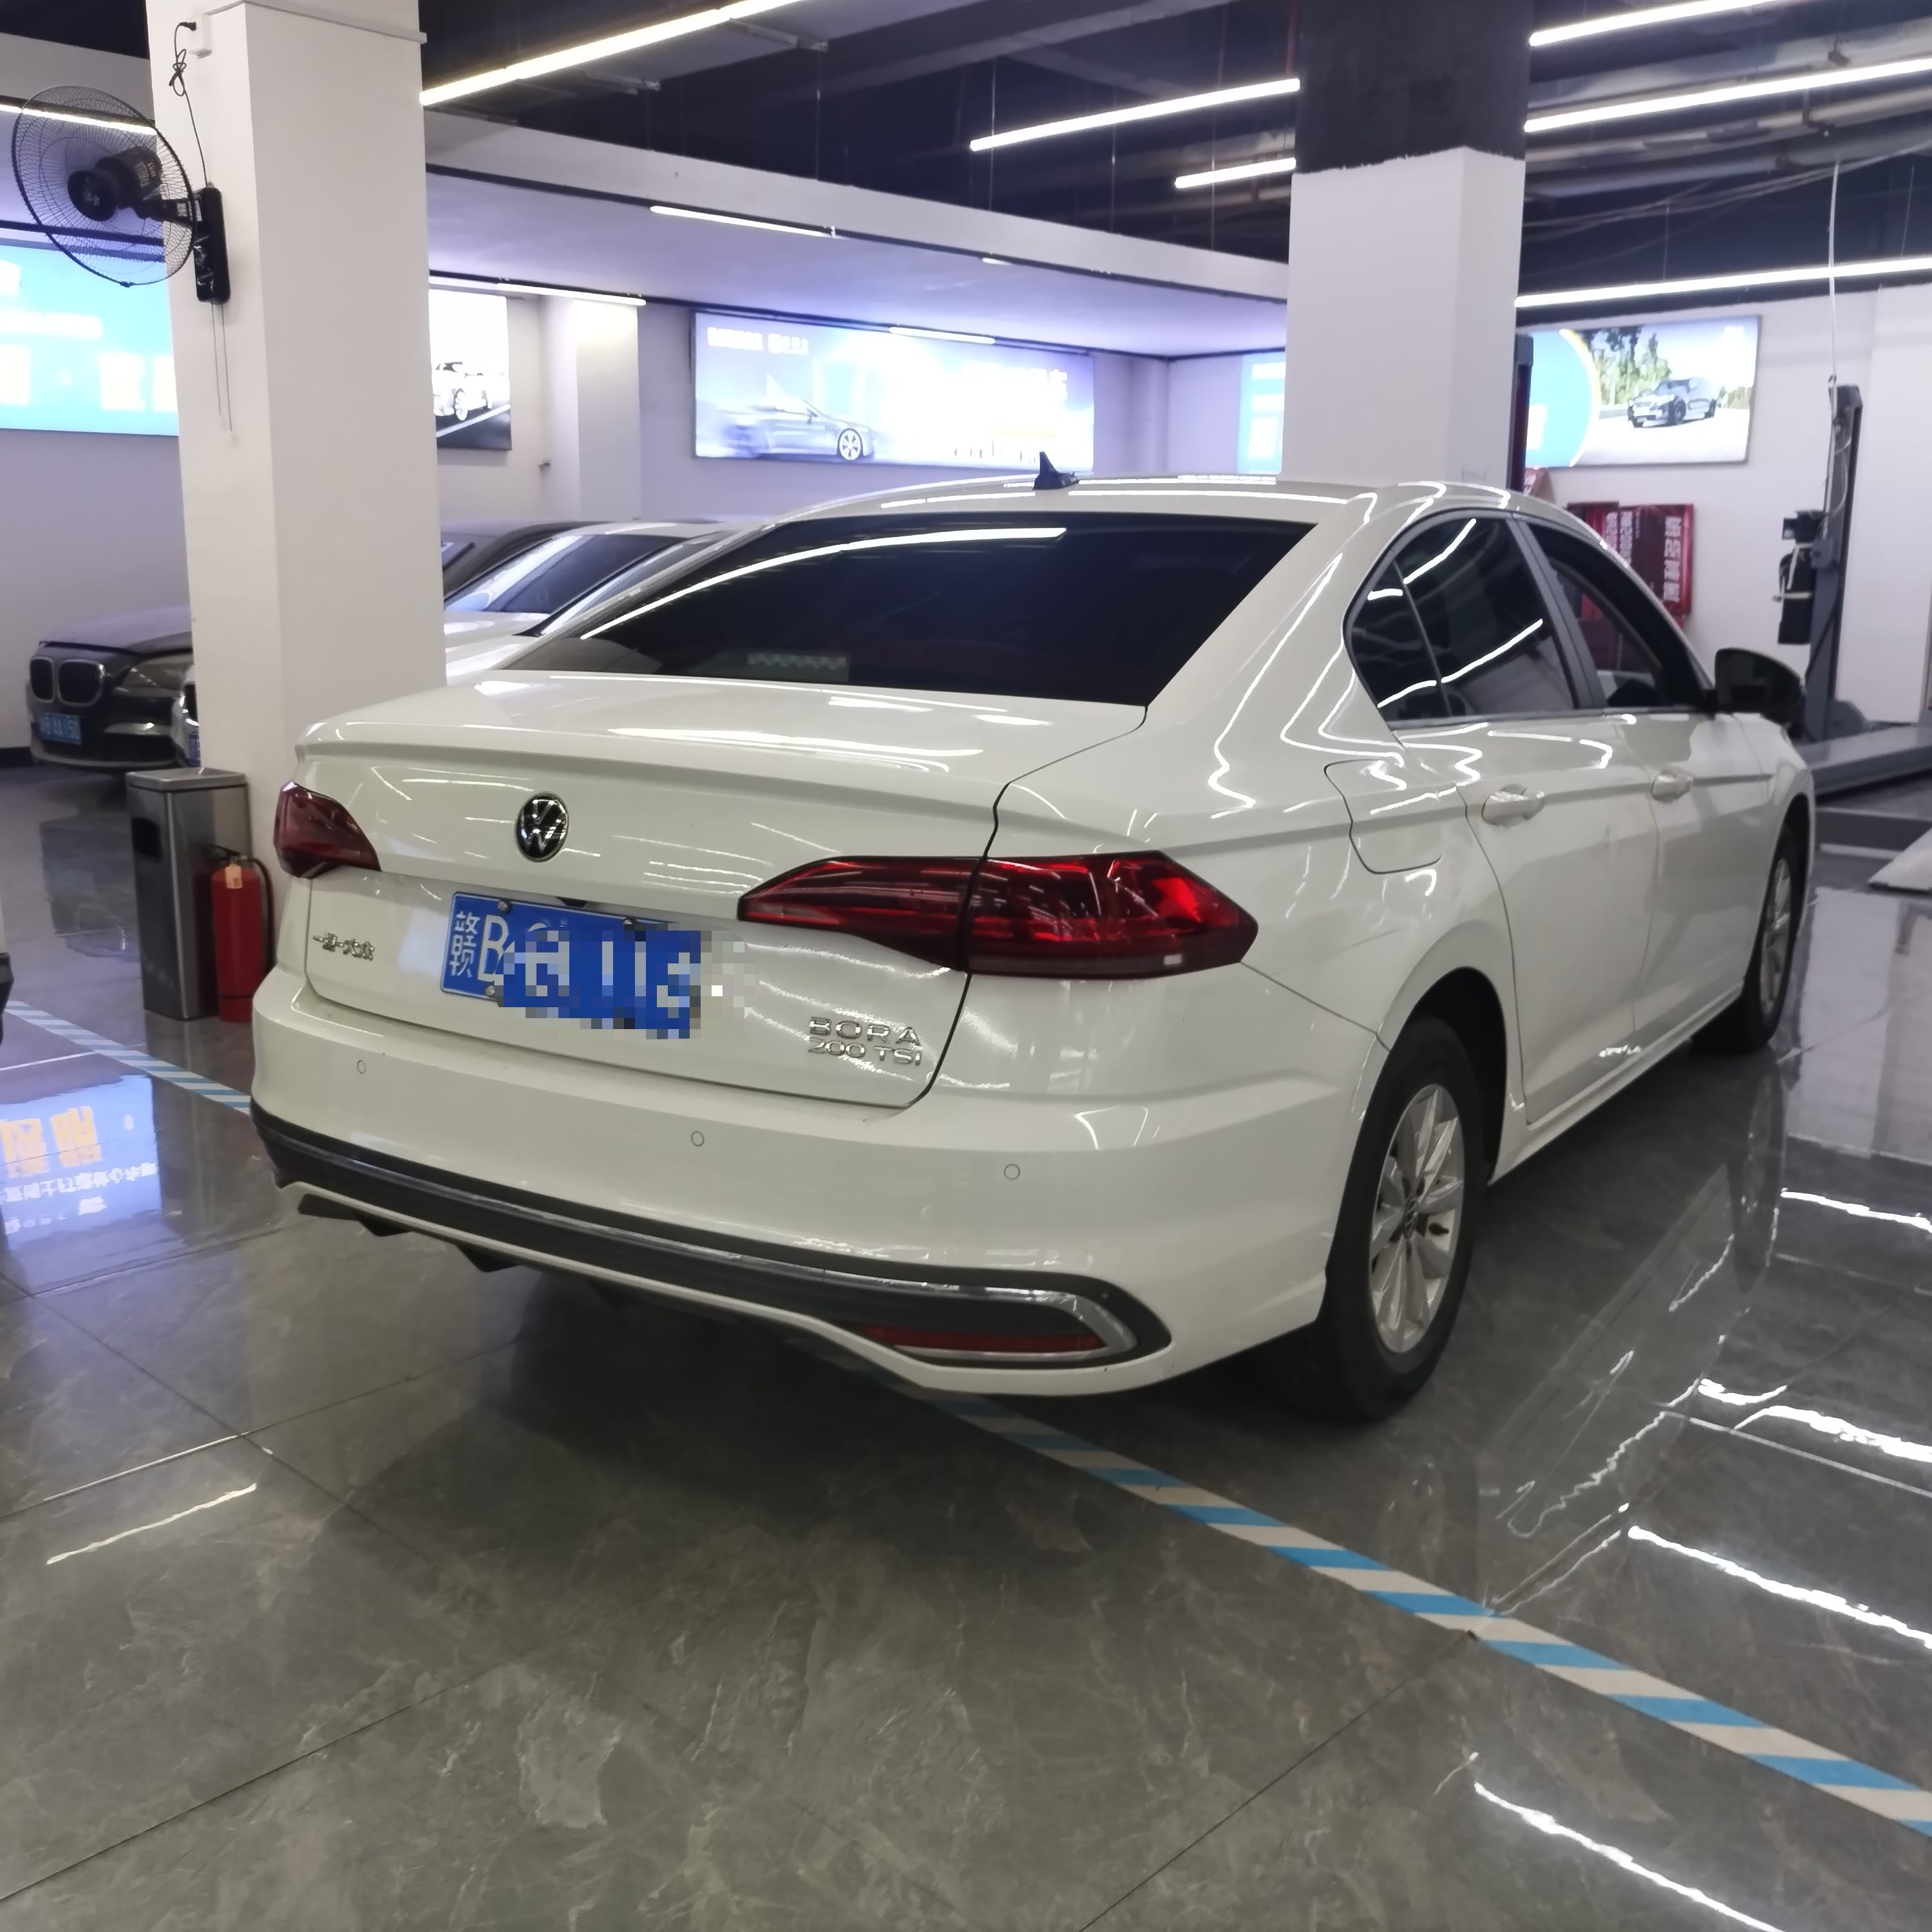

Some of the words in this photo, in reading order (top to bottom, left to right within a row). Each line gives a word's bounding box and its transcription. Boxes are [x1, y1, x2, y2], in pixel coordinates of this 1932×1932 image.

[809, 1016, 922, 1046] BORA
[808, 1036, 867, 1059] 200
[873, 1045, 922, 1066] TSI
